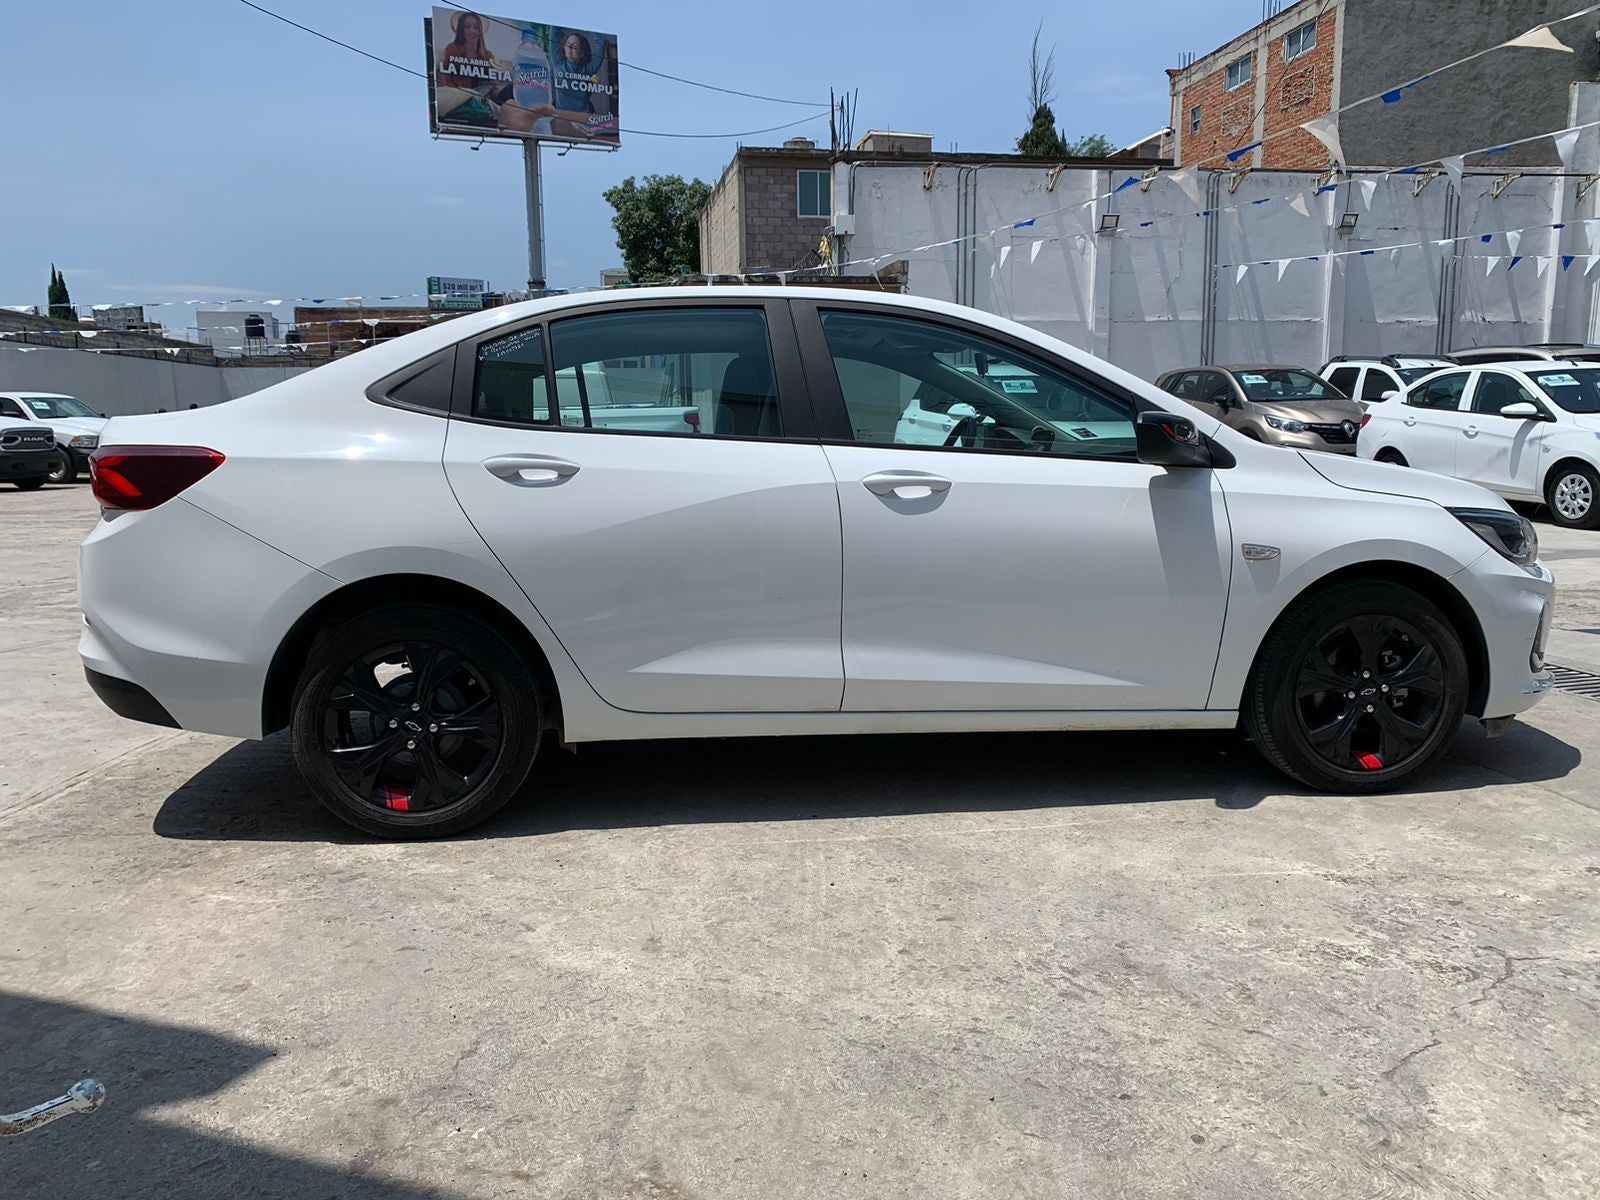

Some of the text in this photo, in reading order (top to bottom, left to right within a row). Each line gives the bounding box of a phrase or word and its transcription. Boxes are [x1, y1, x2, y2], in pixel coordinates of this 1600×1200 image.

[449, 55, 469, 64] PARA
[439, 61, 512, 82] LA MALETA
[554, 78, 613, 95] LA COMPU
